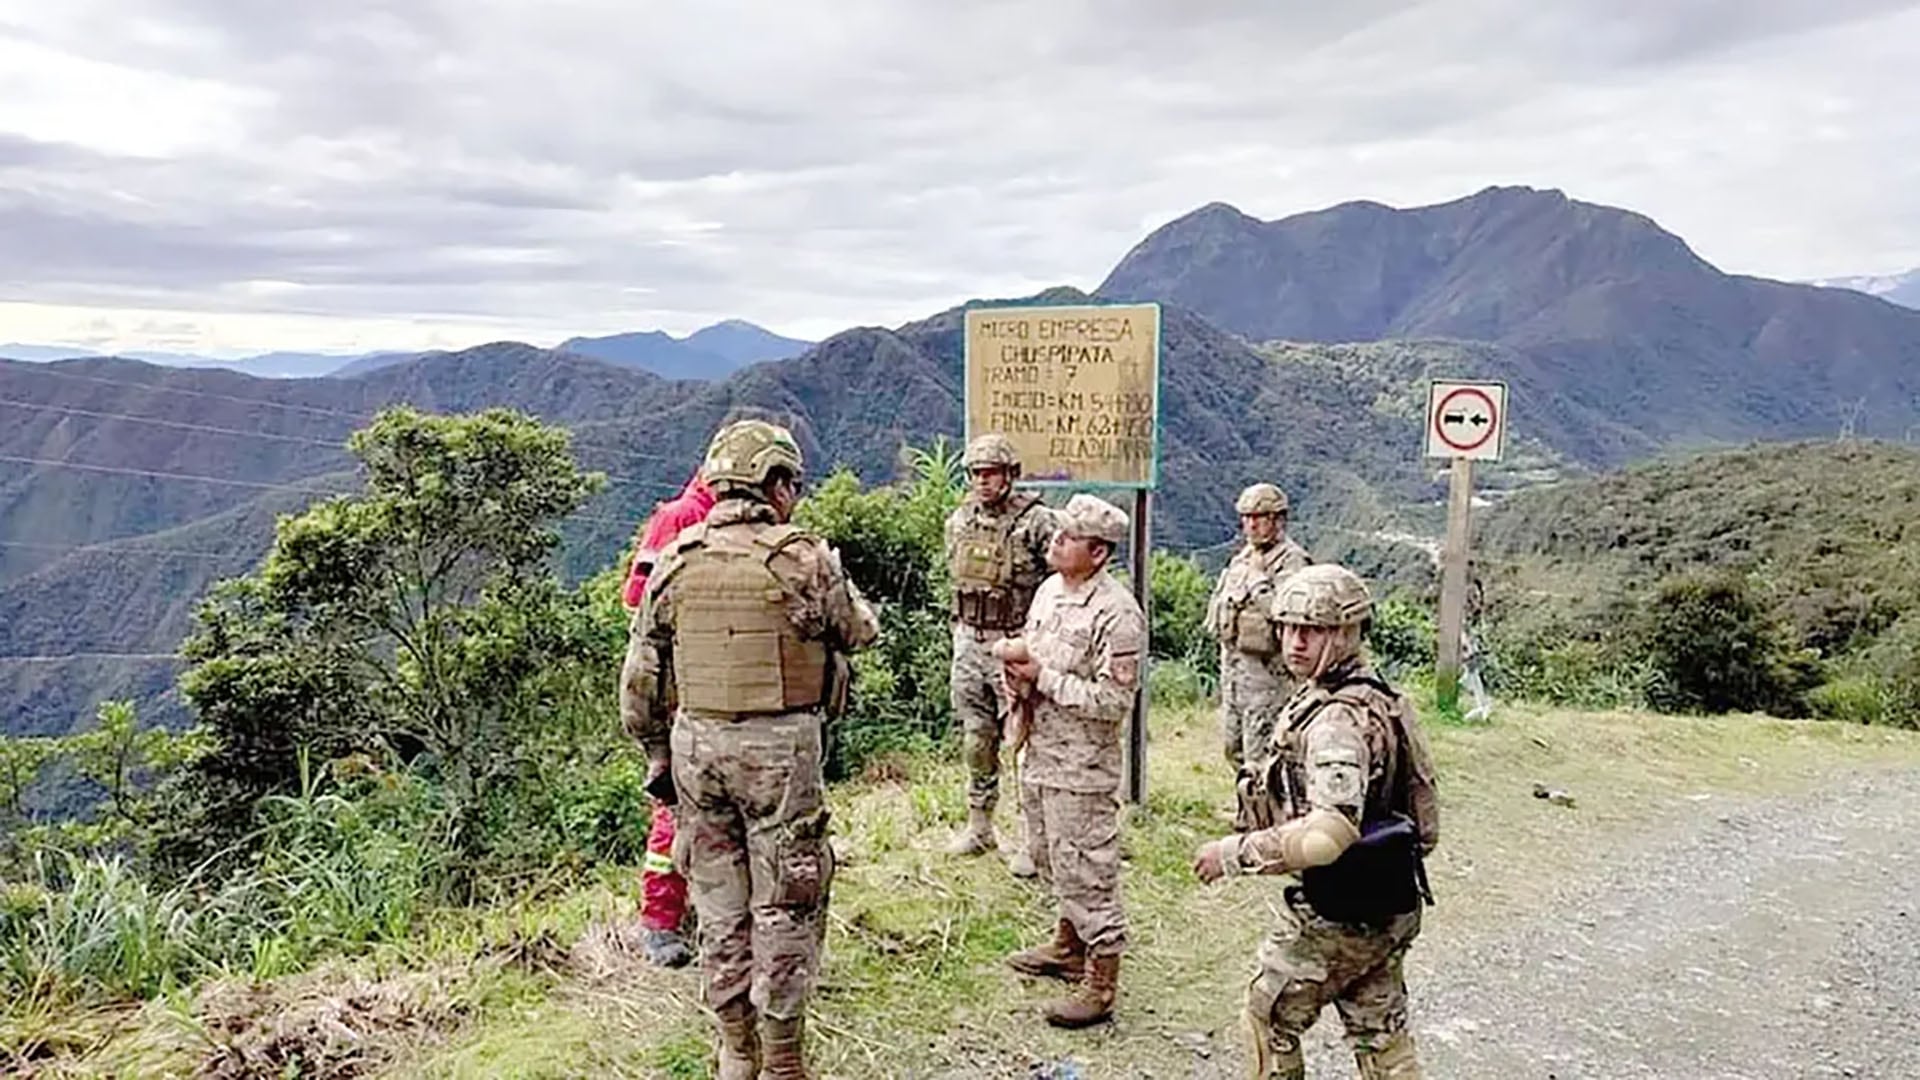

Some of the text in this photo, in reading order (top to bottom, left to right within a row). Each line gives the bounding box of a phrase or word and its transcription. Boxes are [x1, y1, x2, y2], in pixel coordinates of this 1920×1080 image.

[980, 318, 1134, 342] MICRO EMPRESA
[1001, 344, 1115, 364] CHUSPIPATA
[983, 365, 1039, 384] TRAMO
